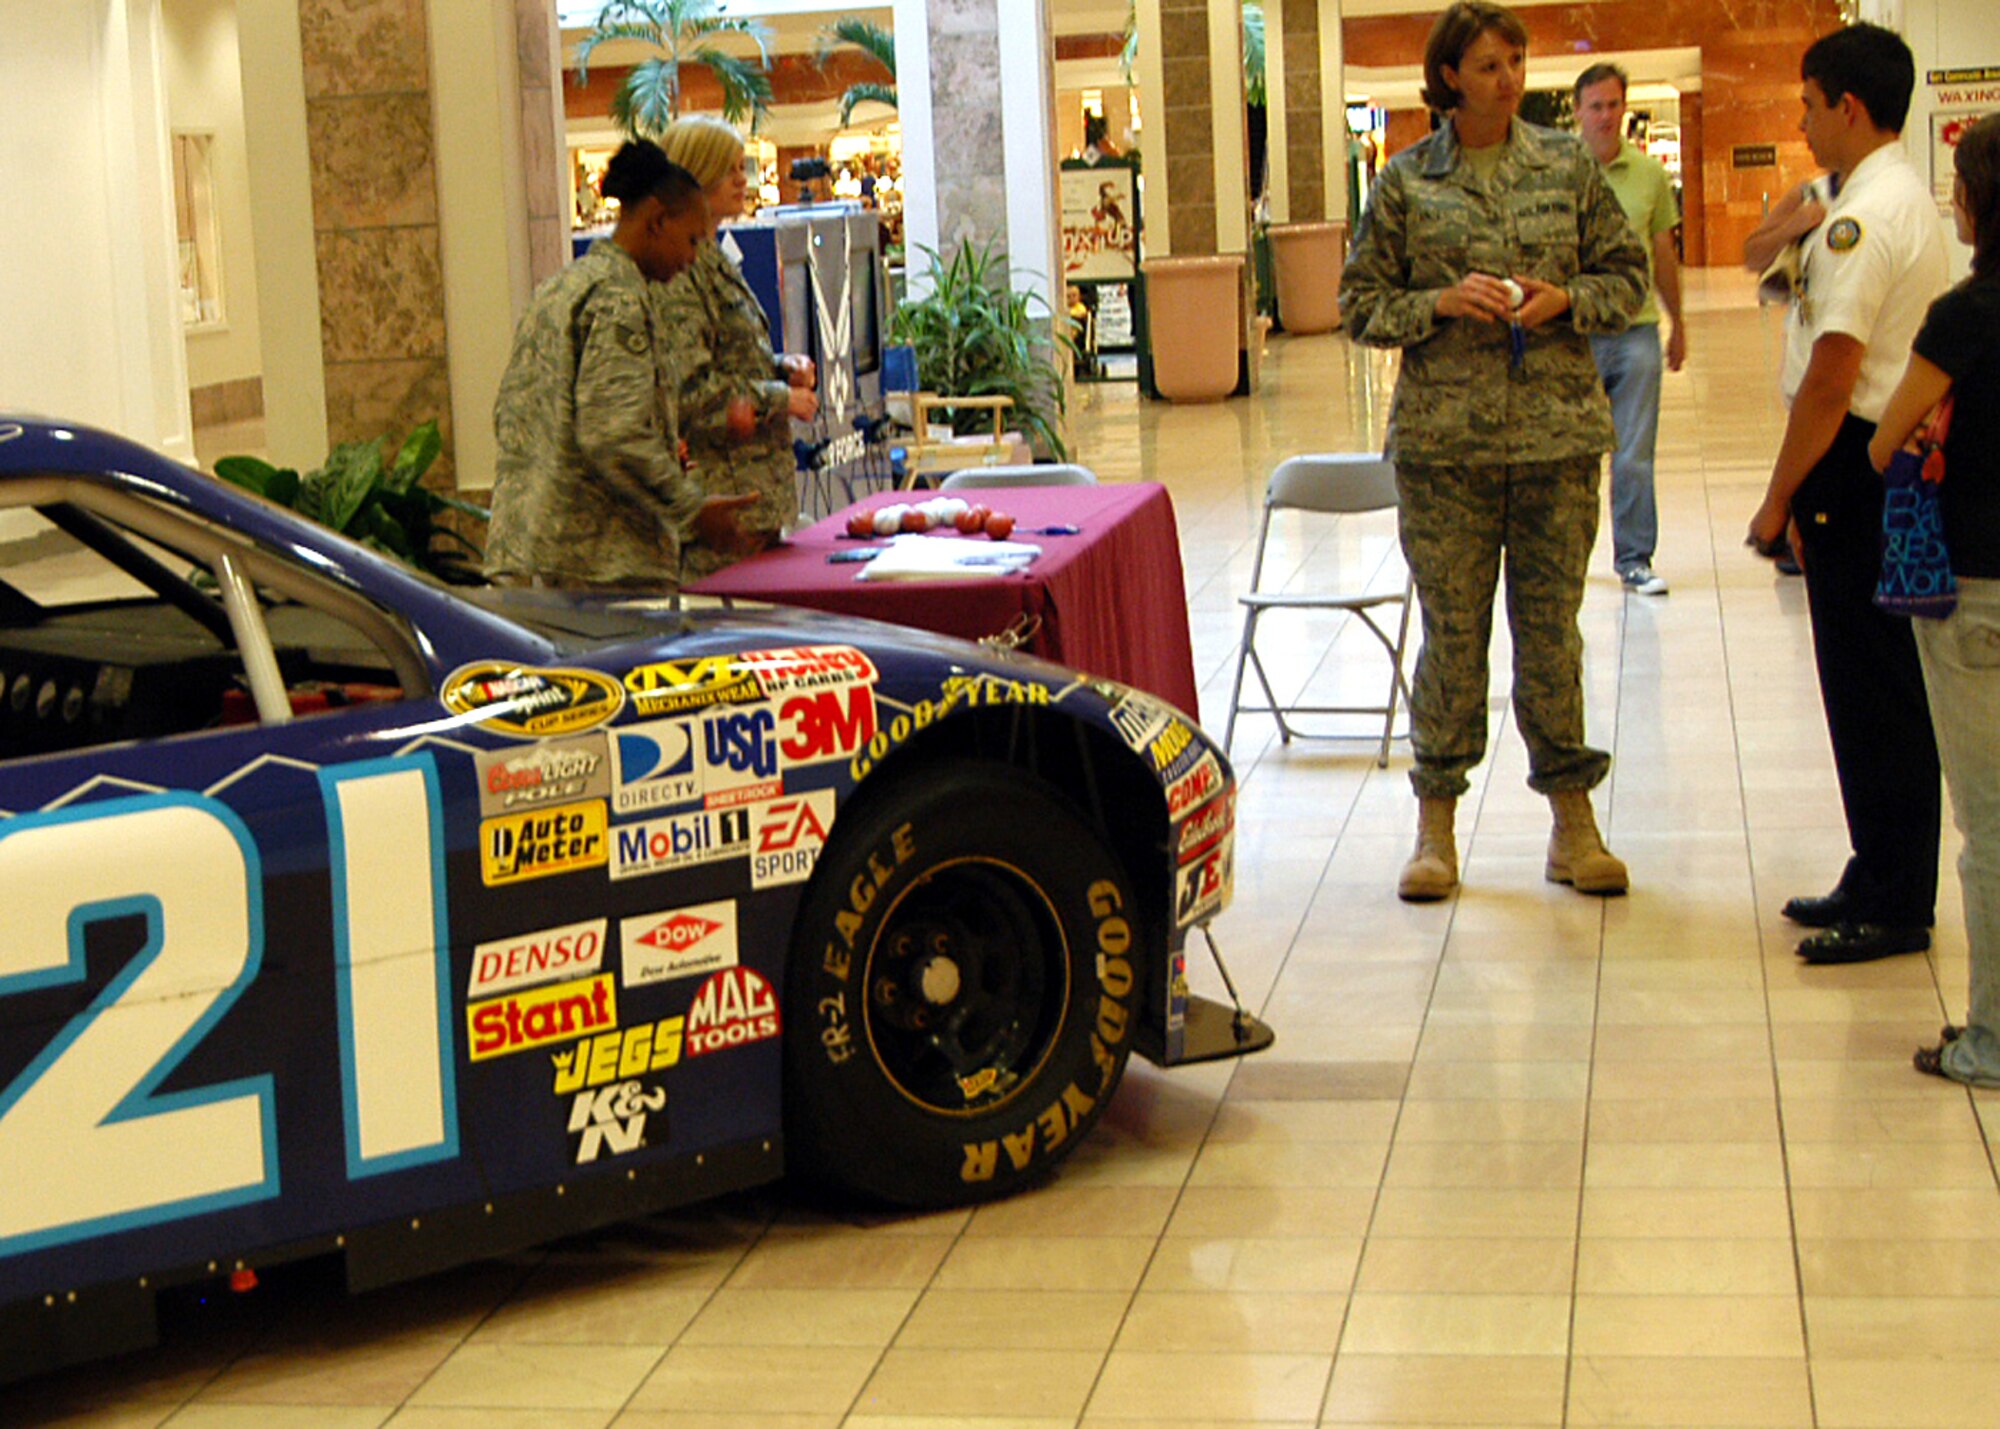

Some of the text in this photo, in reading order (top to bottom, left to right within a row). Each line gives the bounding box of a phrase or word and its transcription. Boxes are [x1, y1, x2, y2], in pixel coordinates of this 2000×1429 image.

[703, 709, 778, 778] USG
[779, 685, 874, 760] 3M
[620, 782, 694, 808] DIRECTV
[514, 834, 599, 873] Meter
[520, 813, 584, 842] Auto
[619, 815, 710, 865] Mobil
[758, 801, 828, 852] EA
[755, 849, 819, 879] SPORT
[823, 822, 916, 981] EAGLE
[478, 930, 598, 983] DENSO
[0, 752, 459, 1257] 21
[474, 979, 610, 1053] Stant
[689, 969, 776, 1031] MAC
[551, 1016, 684, 1095] JEGS
[690, 1015, 777, 1053] TOOLS
[567, 1080, 666, 1164] K&N
